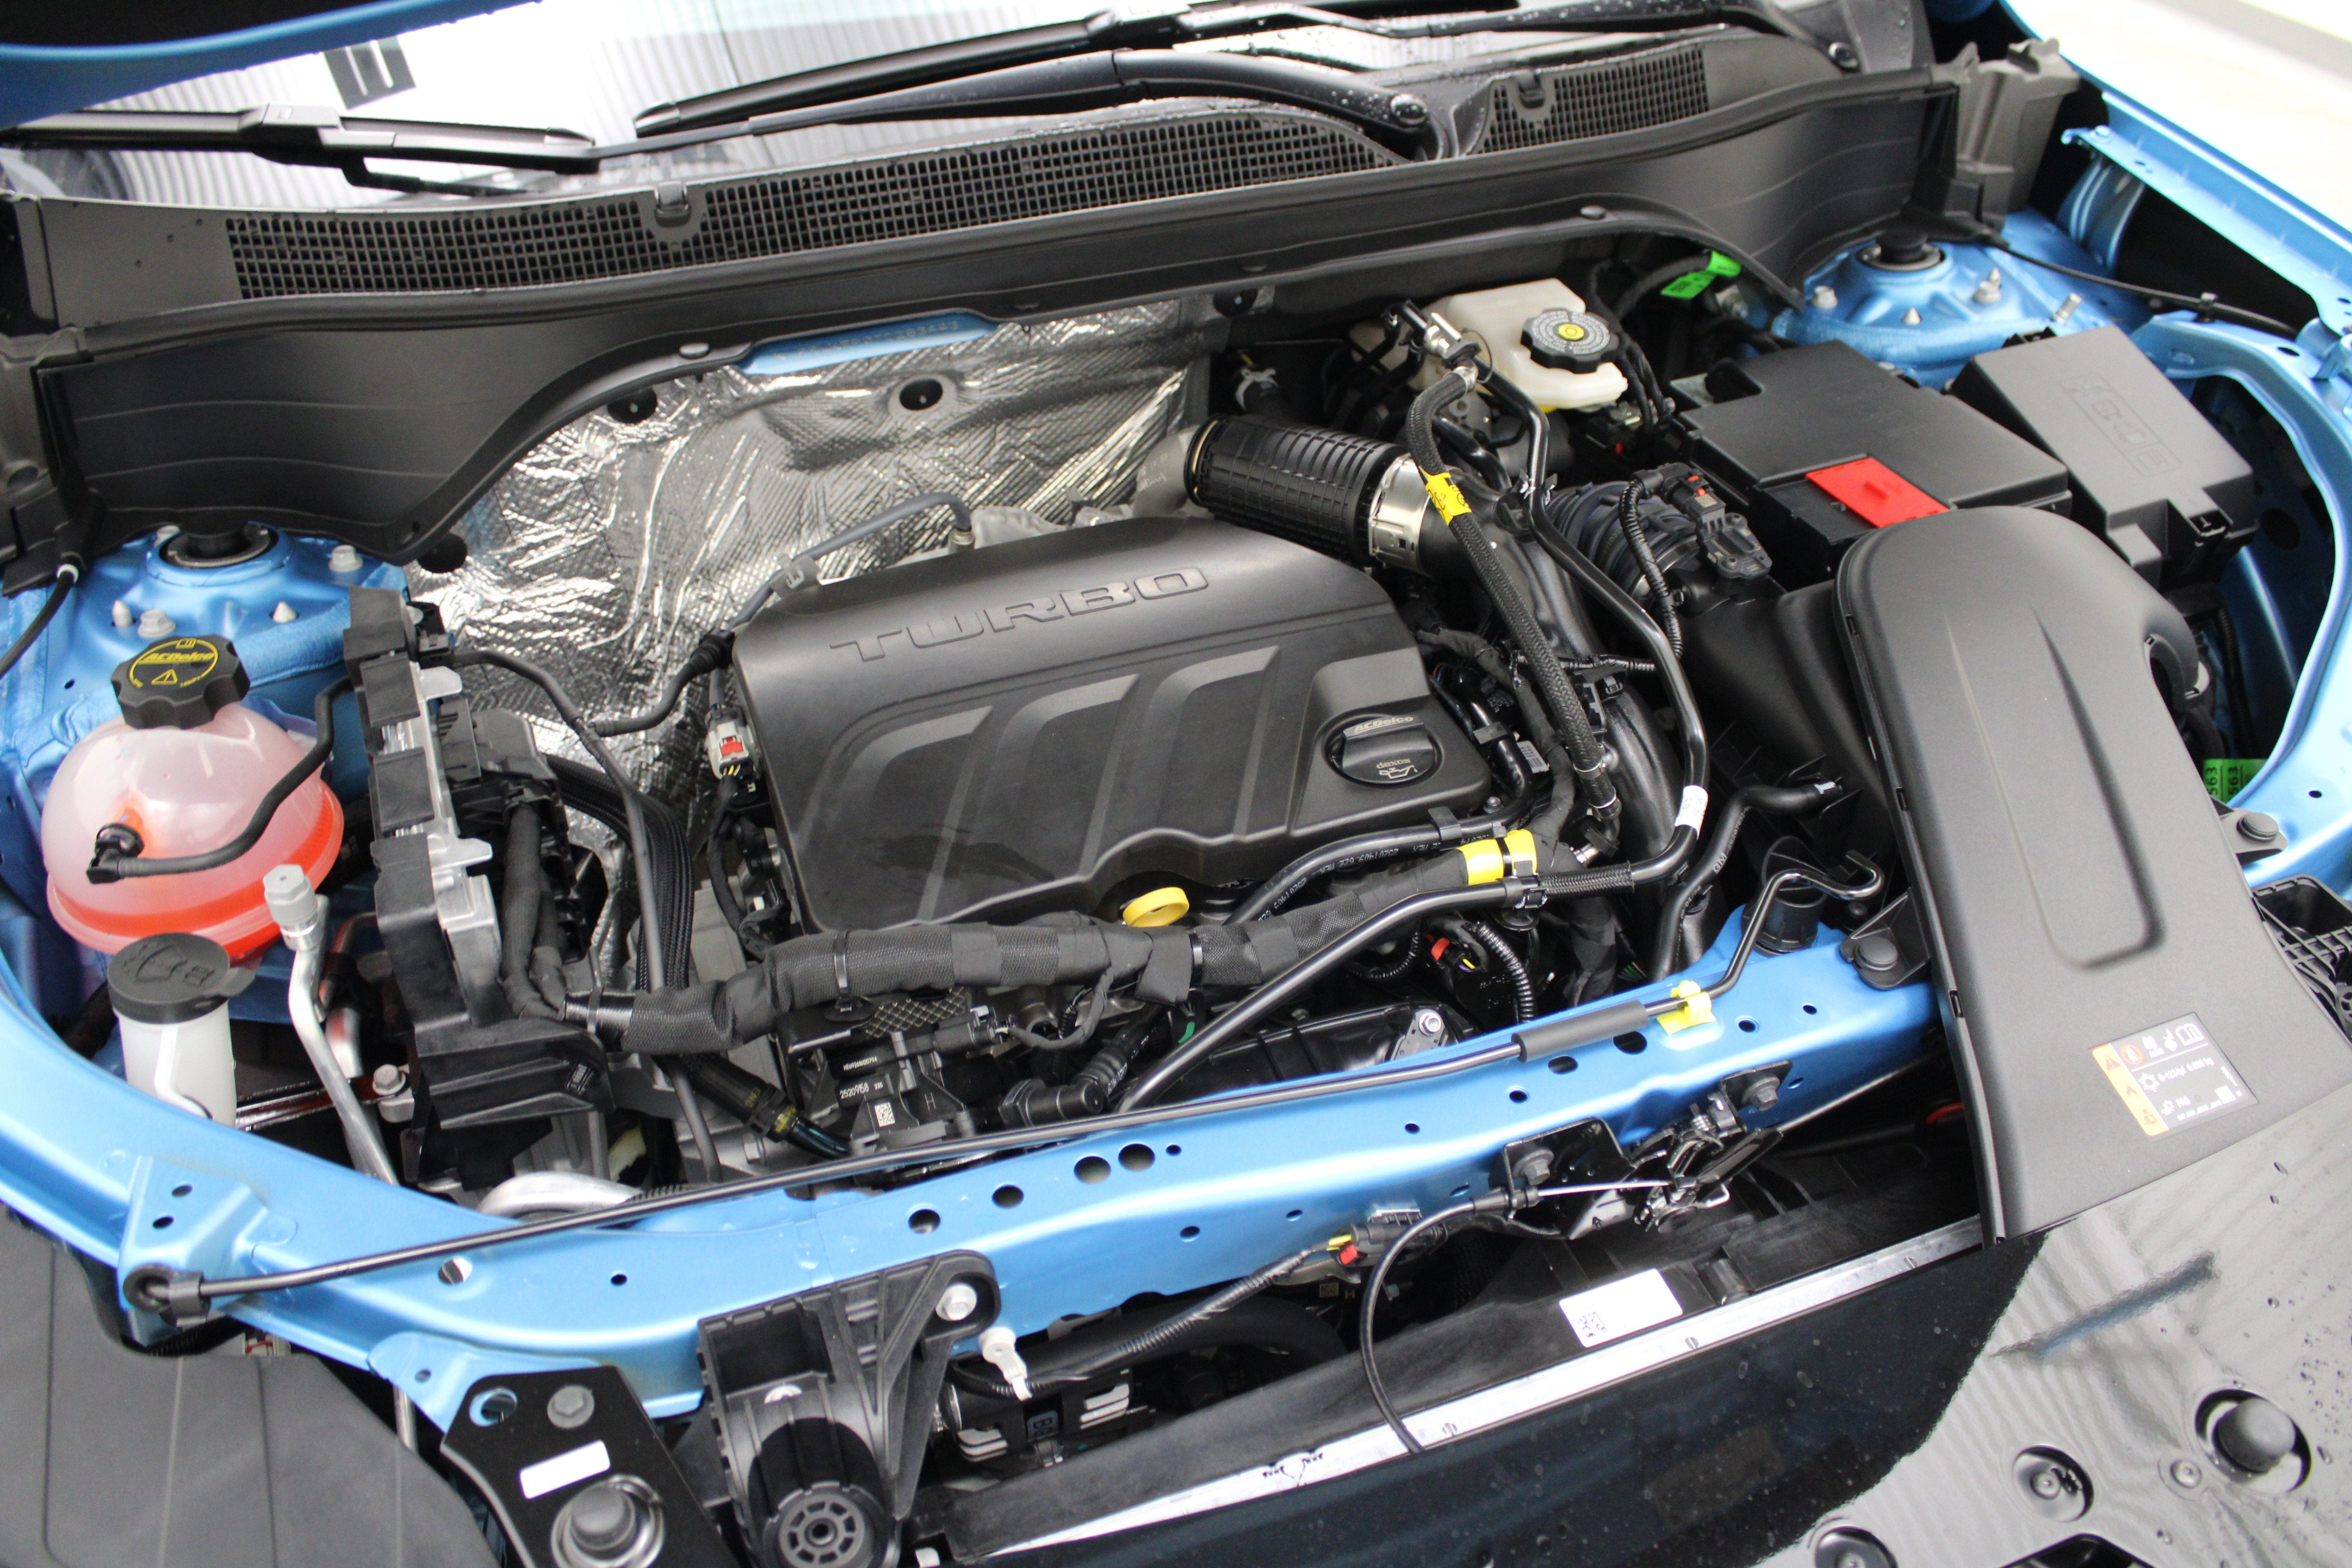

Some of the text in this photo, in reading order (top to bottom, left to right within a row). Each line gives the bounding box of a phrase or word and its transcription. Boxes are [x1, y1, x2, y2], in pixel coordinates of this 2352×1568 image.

[830, 568, 1209, 662] TURBO
[1354, 716, 1414, 733] ACDelco
[1376, 758, 1412, 769] dexos
[1713, 852, 1728, 874] GM
